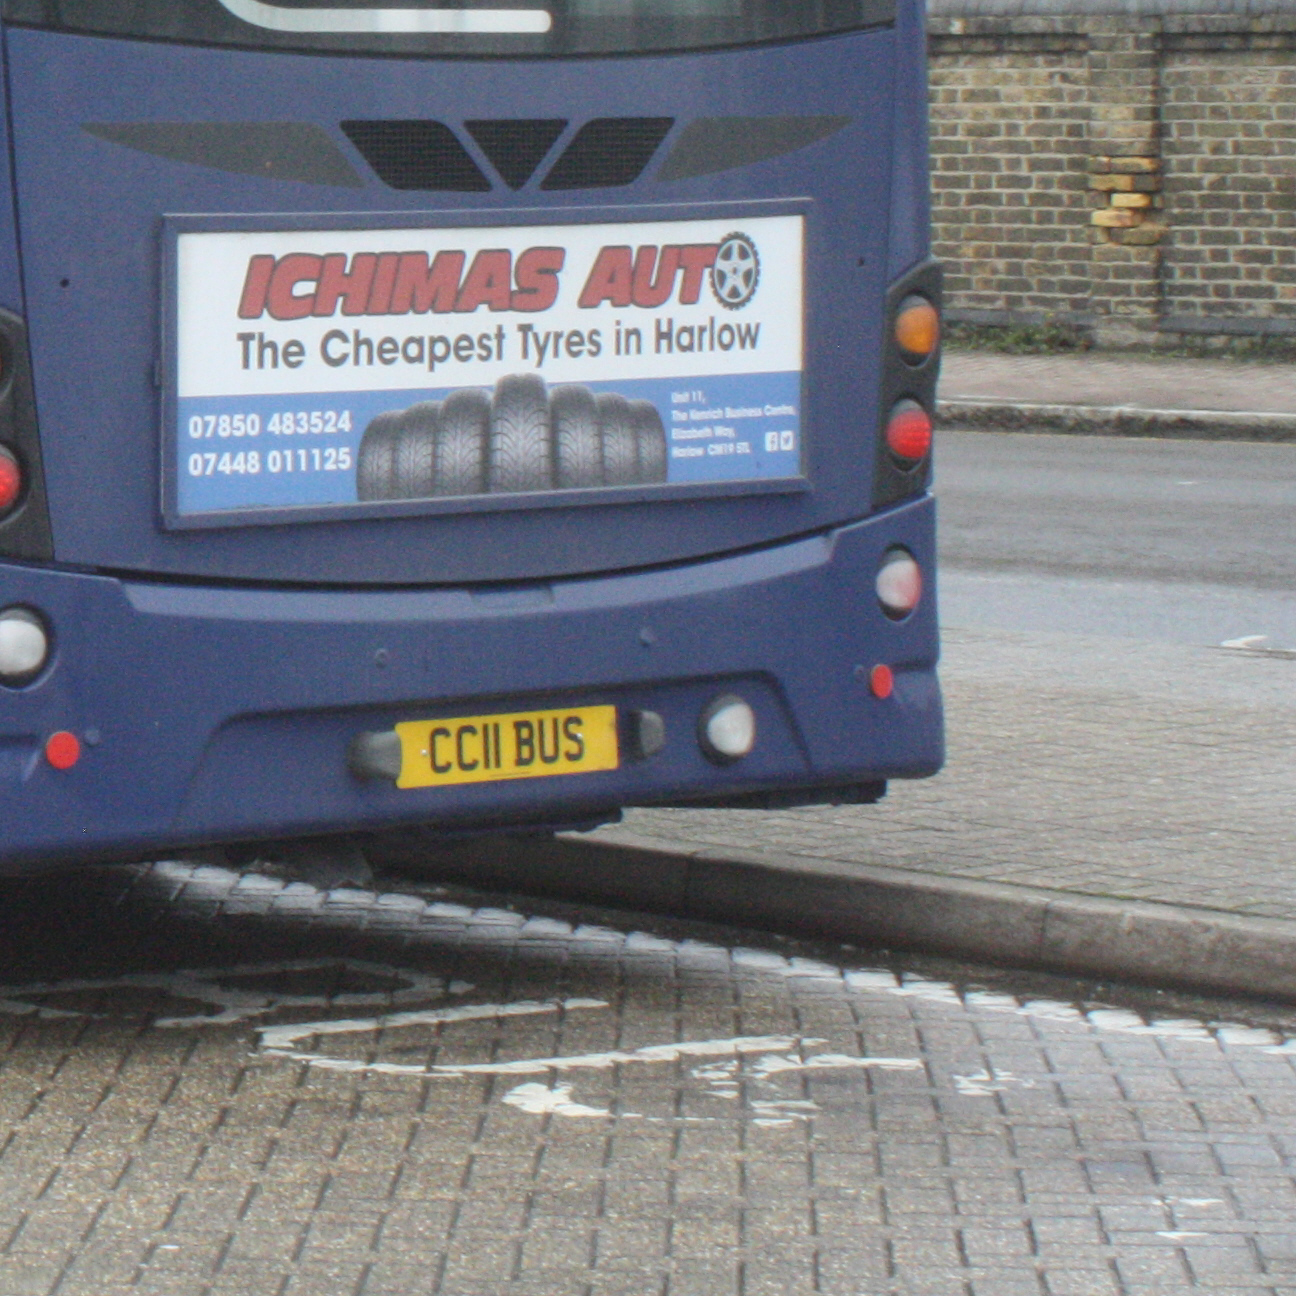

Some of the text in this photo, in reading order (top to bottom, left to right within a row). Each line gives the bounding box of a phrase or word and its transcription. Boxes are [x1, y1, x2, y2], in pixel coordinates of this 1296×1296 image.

[237, 245, 566, 320] ICHIMAS
[236, 316, 761, 373] The Cheapest Tyres in Harlow
[188, 410, 352, 439] 07850 483524
[188, 447, 352, 476] 07448 011125
[429, 716, 585, 774] CC11 BUS
